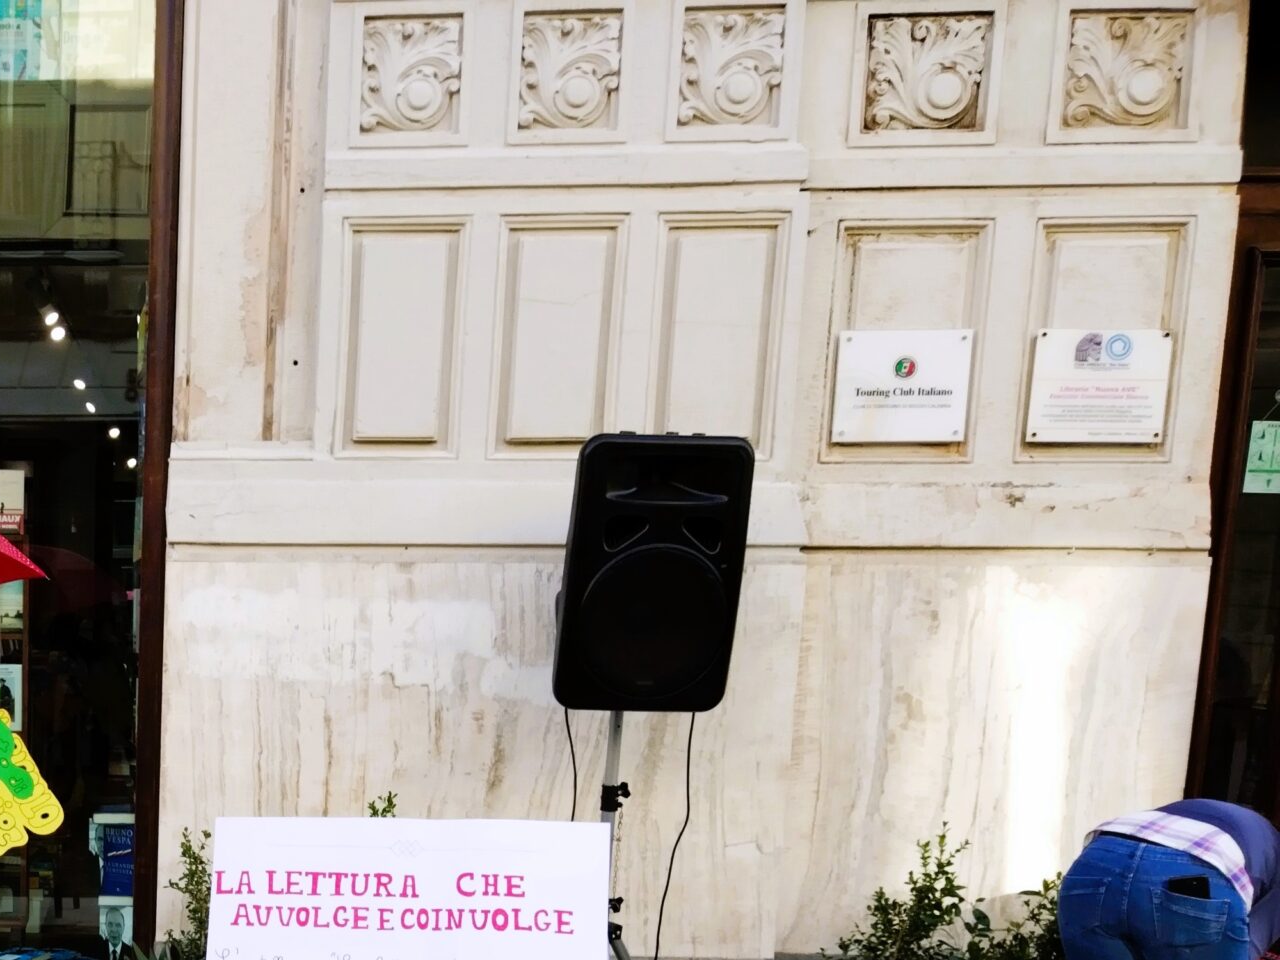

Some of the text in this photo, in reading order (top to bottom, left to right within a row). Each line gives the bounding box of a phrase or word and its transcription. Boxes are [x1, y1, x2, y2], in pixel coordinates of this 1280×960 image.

[855, 387, 953, 399] Touring Club Italiano
[106, 827, 133, 837] BRUNO
[107, 834, 131, 845] VESPA
[215, 871, 526, 898] LA LETTURA CHE
[230, 904, 575, 934] AVVOLGE E COINVOLGE
